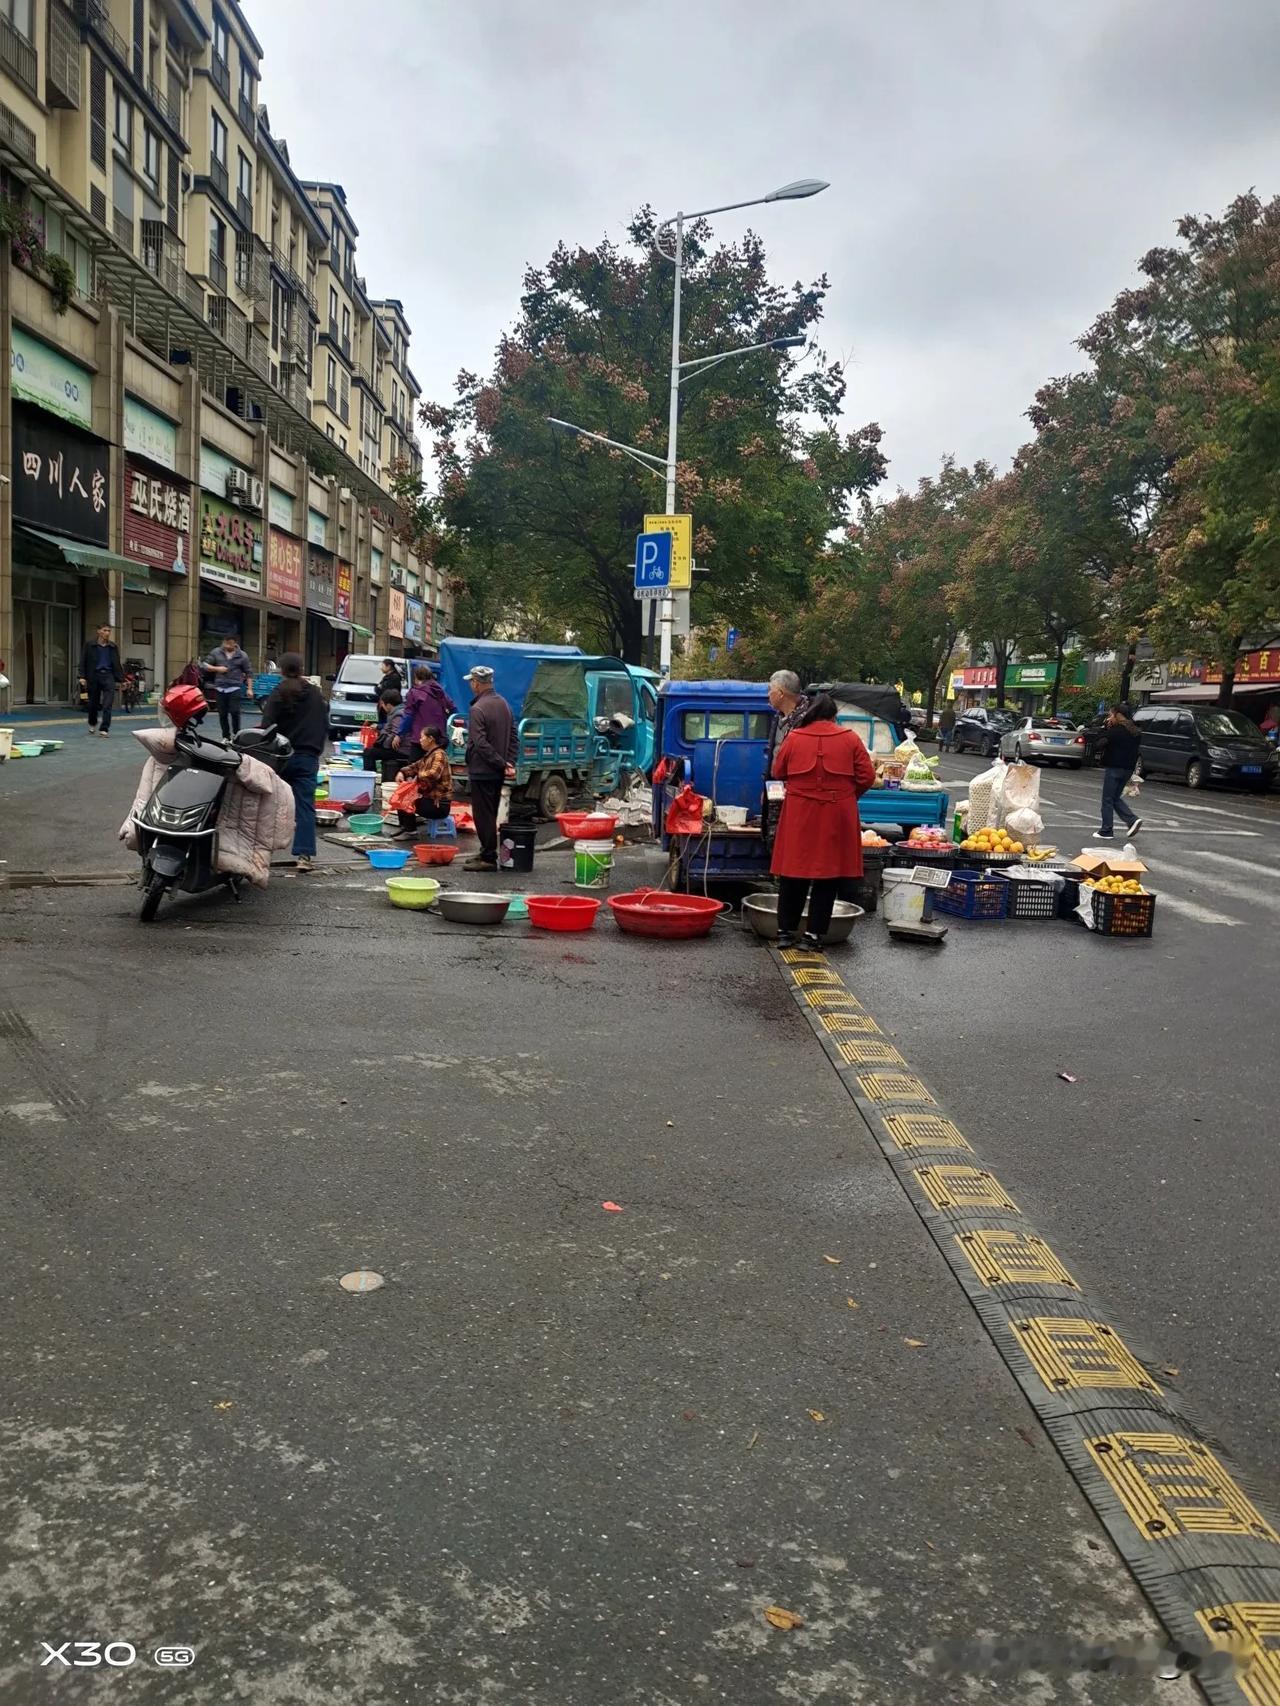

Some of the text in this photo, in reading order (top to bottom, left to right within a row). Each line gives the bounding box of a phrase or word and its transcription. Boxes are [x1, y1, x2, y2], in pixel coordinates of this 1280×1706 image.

[23, 451, 106, 513] 四川人家
[130, 471, 190, 533] 巫氏烧酒
[641, 541, 658, 580] P
